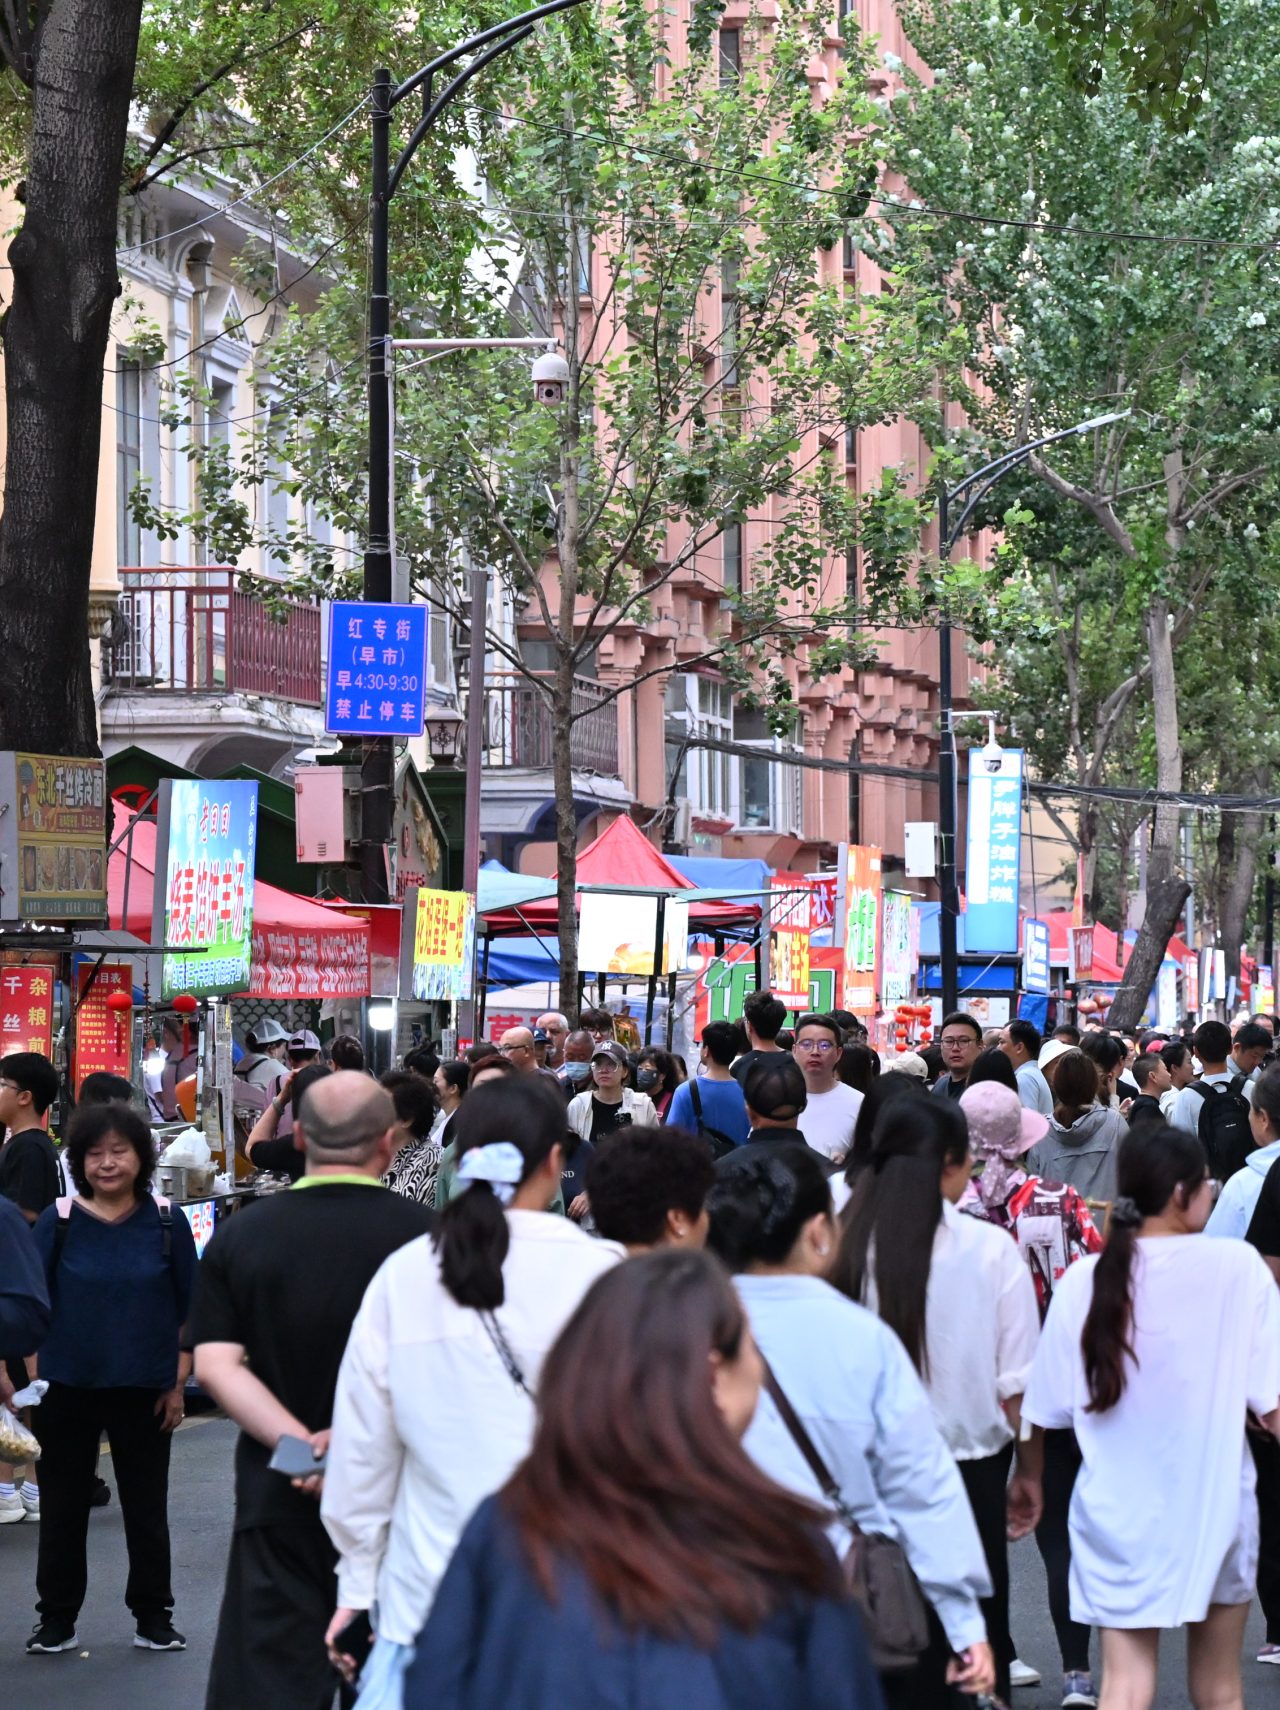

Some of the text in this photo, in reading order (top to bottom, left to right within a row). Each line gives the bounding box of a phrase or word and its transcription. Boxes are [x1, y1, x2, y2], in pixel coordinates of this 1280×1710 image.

[348, 617, 411, 641] 红专街
[336, 698, 416, 721] 禁止停车
[3, 976, 22, 1032] 千丝
